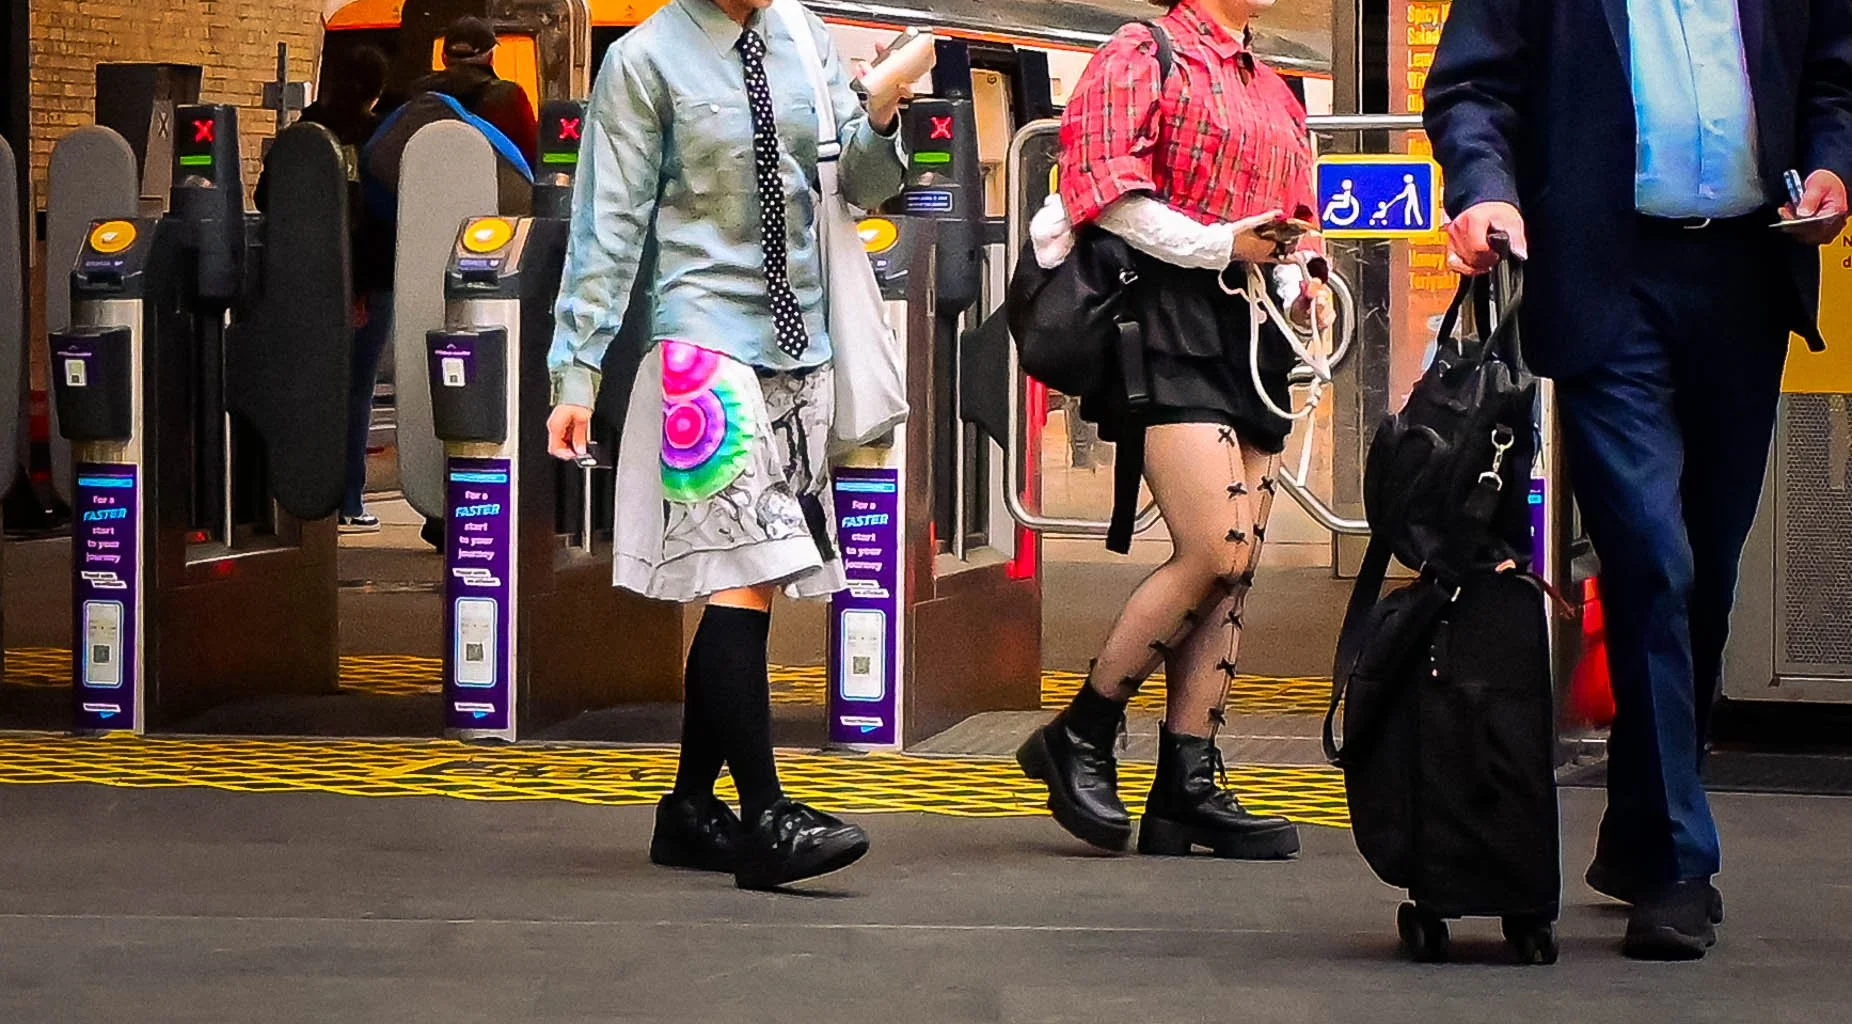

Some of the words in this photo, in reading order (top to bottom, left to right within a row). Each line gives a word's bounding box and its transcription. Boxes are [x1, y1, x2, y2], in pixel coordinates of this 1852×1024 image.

[1407, 4, 1439, 25] Spicy
[455, 504, 500, 517] FASTER
[842, 514, 889, 528] FASTER
